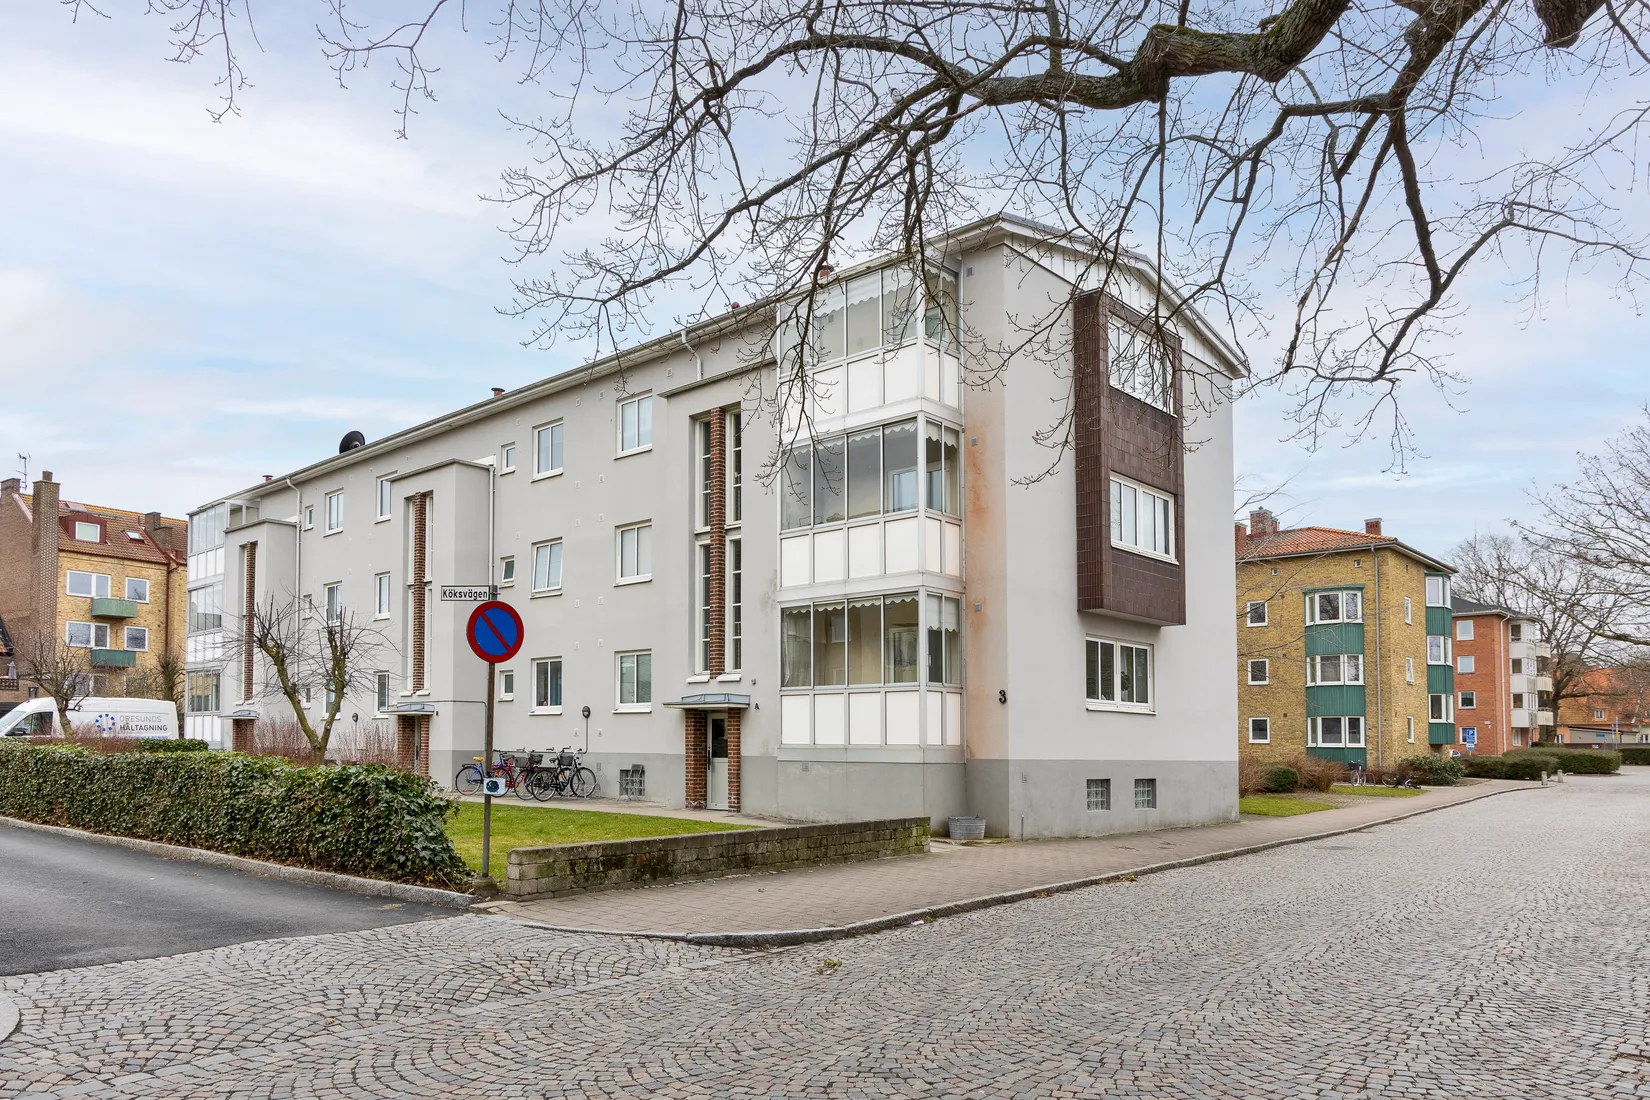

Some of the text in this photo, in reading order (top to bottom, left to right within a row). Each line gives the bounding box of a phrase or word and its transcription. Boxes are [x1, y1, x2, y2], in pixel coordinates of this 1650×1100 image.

[442, 589, 488, 600] Köksvägen
[998, 689, 1007, 704] 3
[754, 702, 760, 710] A
